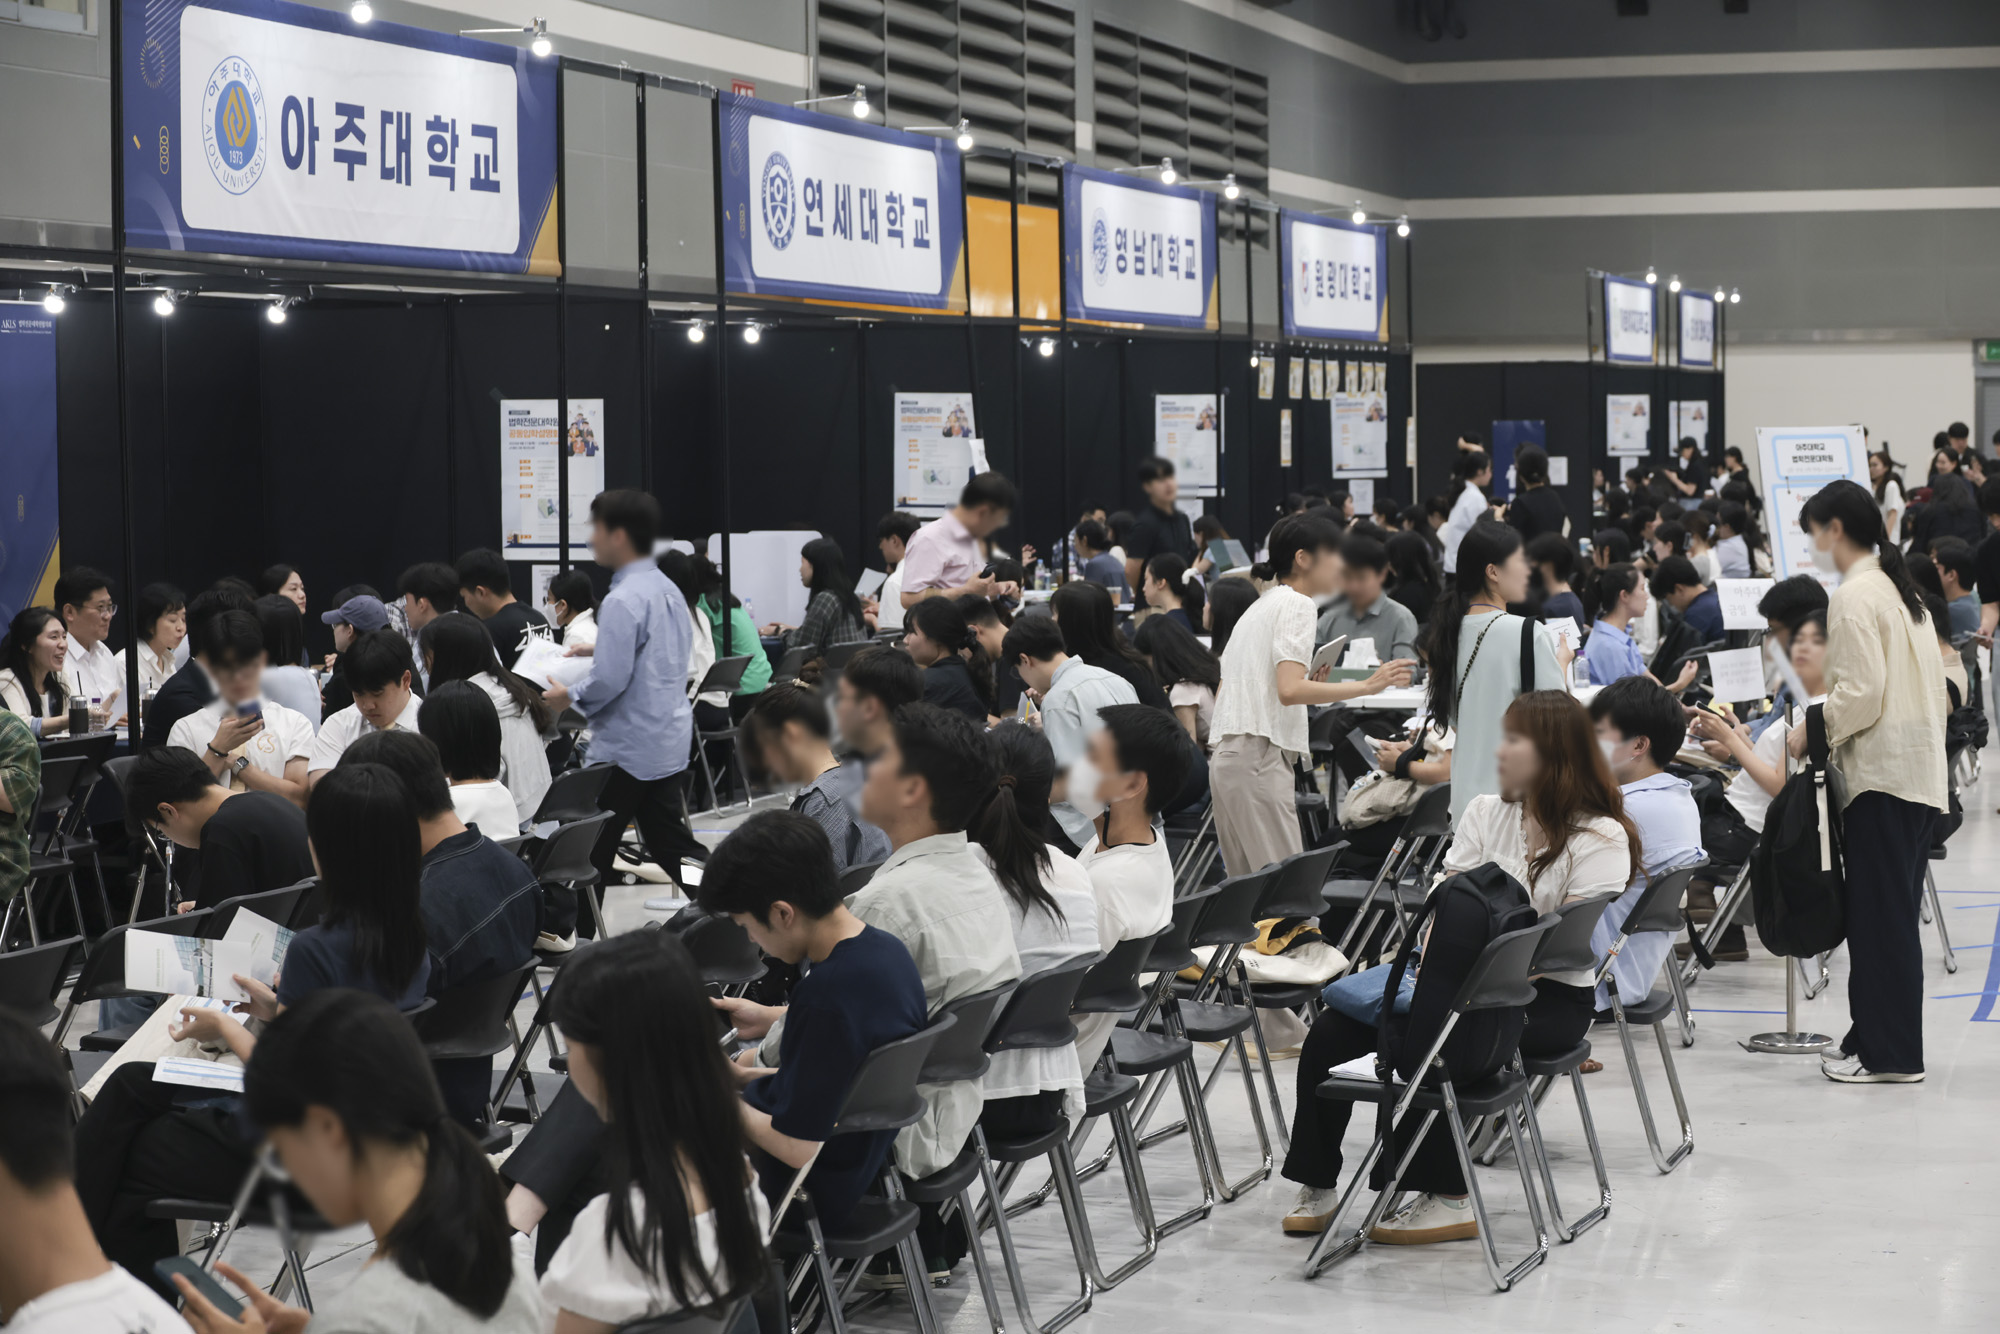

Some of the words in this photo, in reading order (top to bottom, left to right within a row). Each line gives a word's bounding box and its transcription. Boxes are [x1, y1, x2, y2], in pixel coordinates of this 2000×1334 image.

[208, 62, 261, 107] 아주대학교
[205, 123, 221, 170] AJOU
[223, 135, 265, 189] UNIVERSITY
[229, 150, 243, 165] 1973
[280, 95, 501, 194] 아주대학교
[803, 177, 931, 249] 연세대학교
[1115, 227, 1196, 281] 영남대학교
[1315, 259, 1372, 302] 원광대학교
[1795, 443, 1825, 451] 아주대학교
